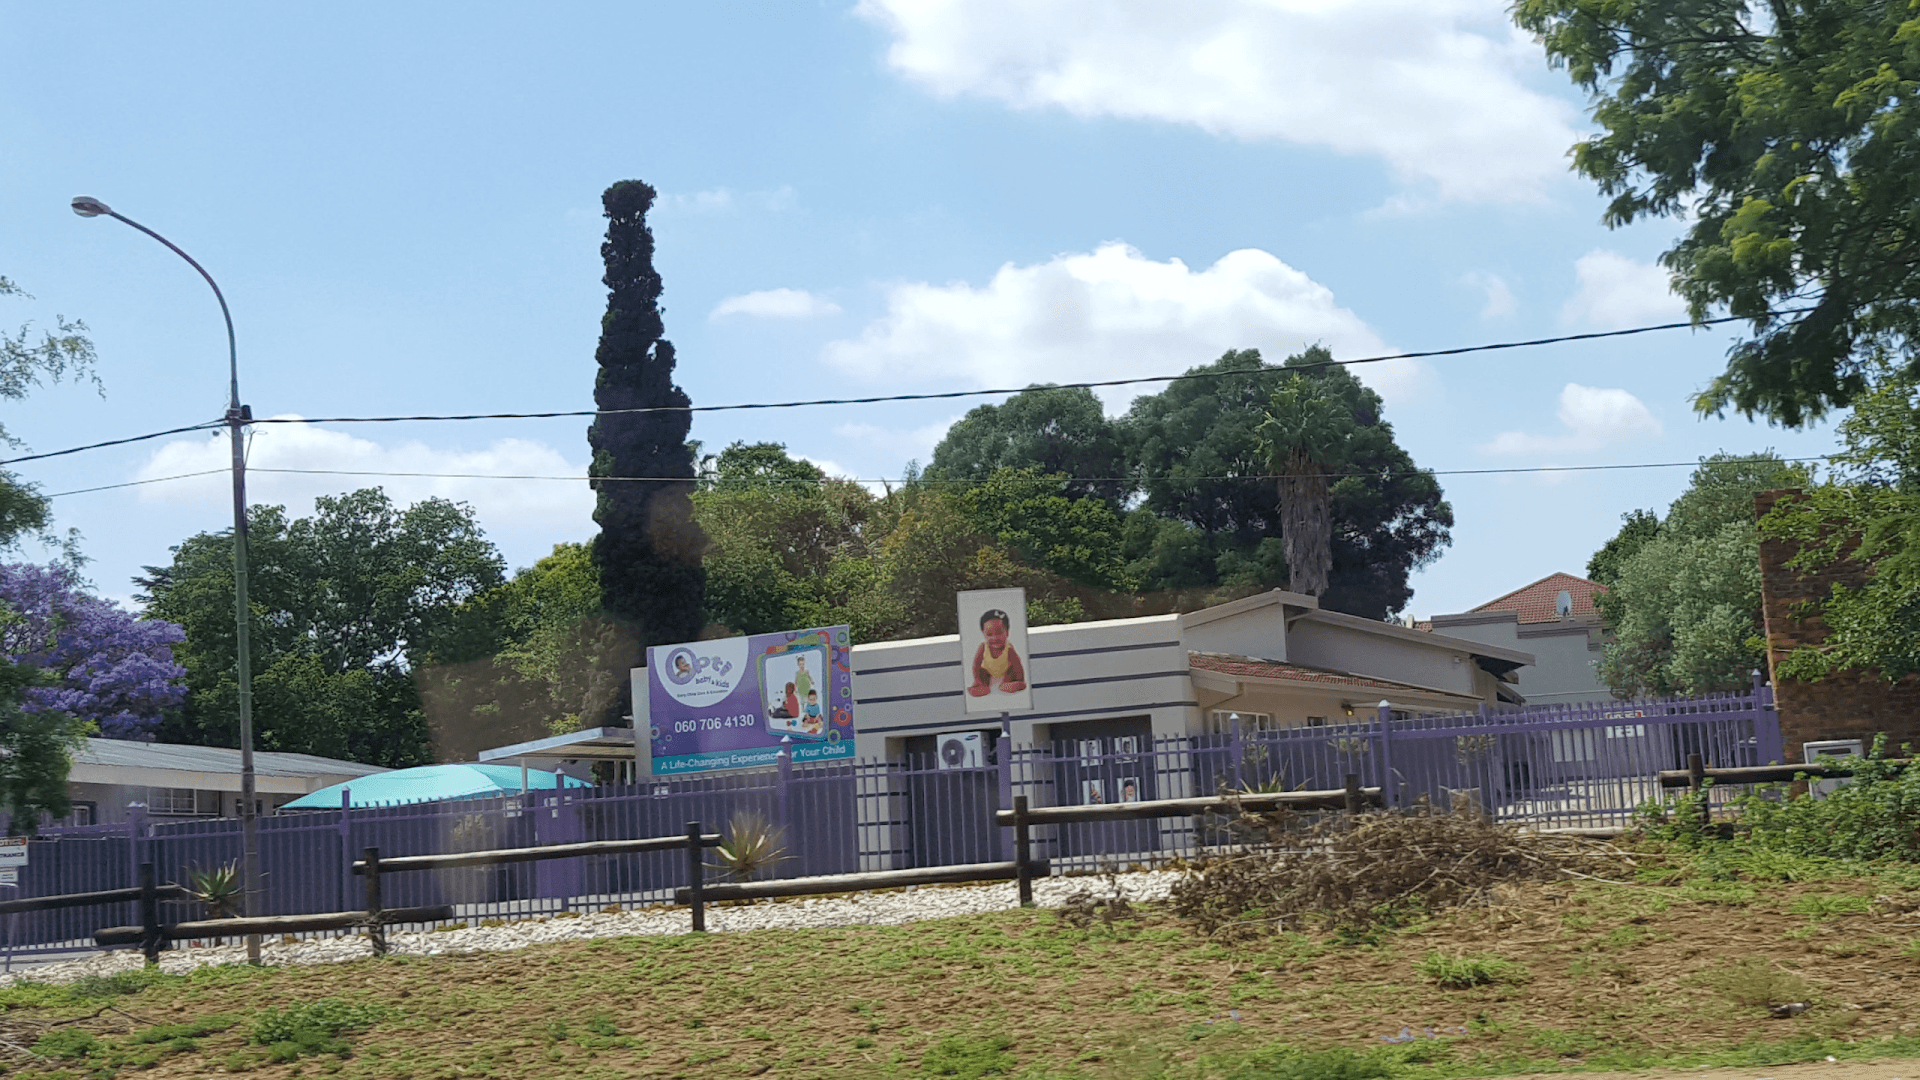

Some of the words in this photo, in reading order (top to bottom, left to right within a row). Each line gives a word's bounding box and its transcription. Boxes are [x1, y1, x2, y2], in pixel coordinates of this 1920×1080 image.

[665, 647, 733, 685] Opti
[695, 676, 711, 685] baby
[715, 680, 730, 689] kids
[674, 719, 697, 733] 060
[699, 716, 722, 731] 706
[724, 713, 755, 729] 4130
[661, 761, 668, 770] A
[669, 757, 730, 770] Life-Changing
[731, 753, 778, 764] Experienc
[800, 747, 821, 758] Your
[822, 745, 846, 755] Child
